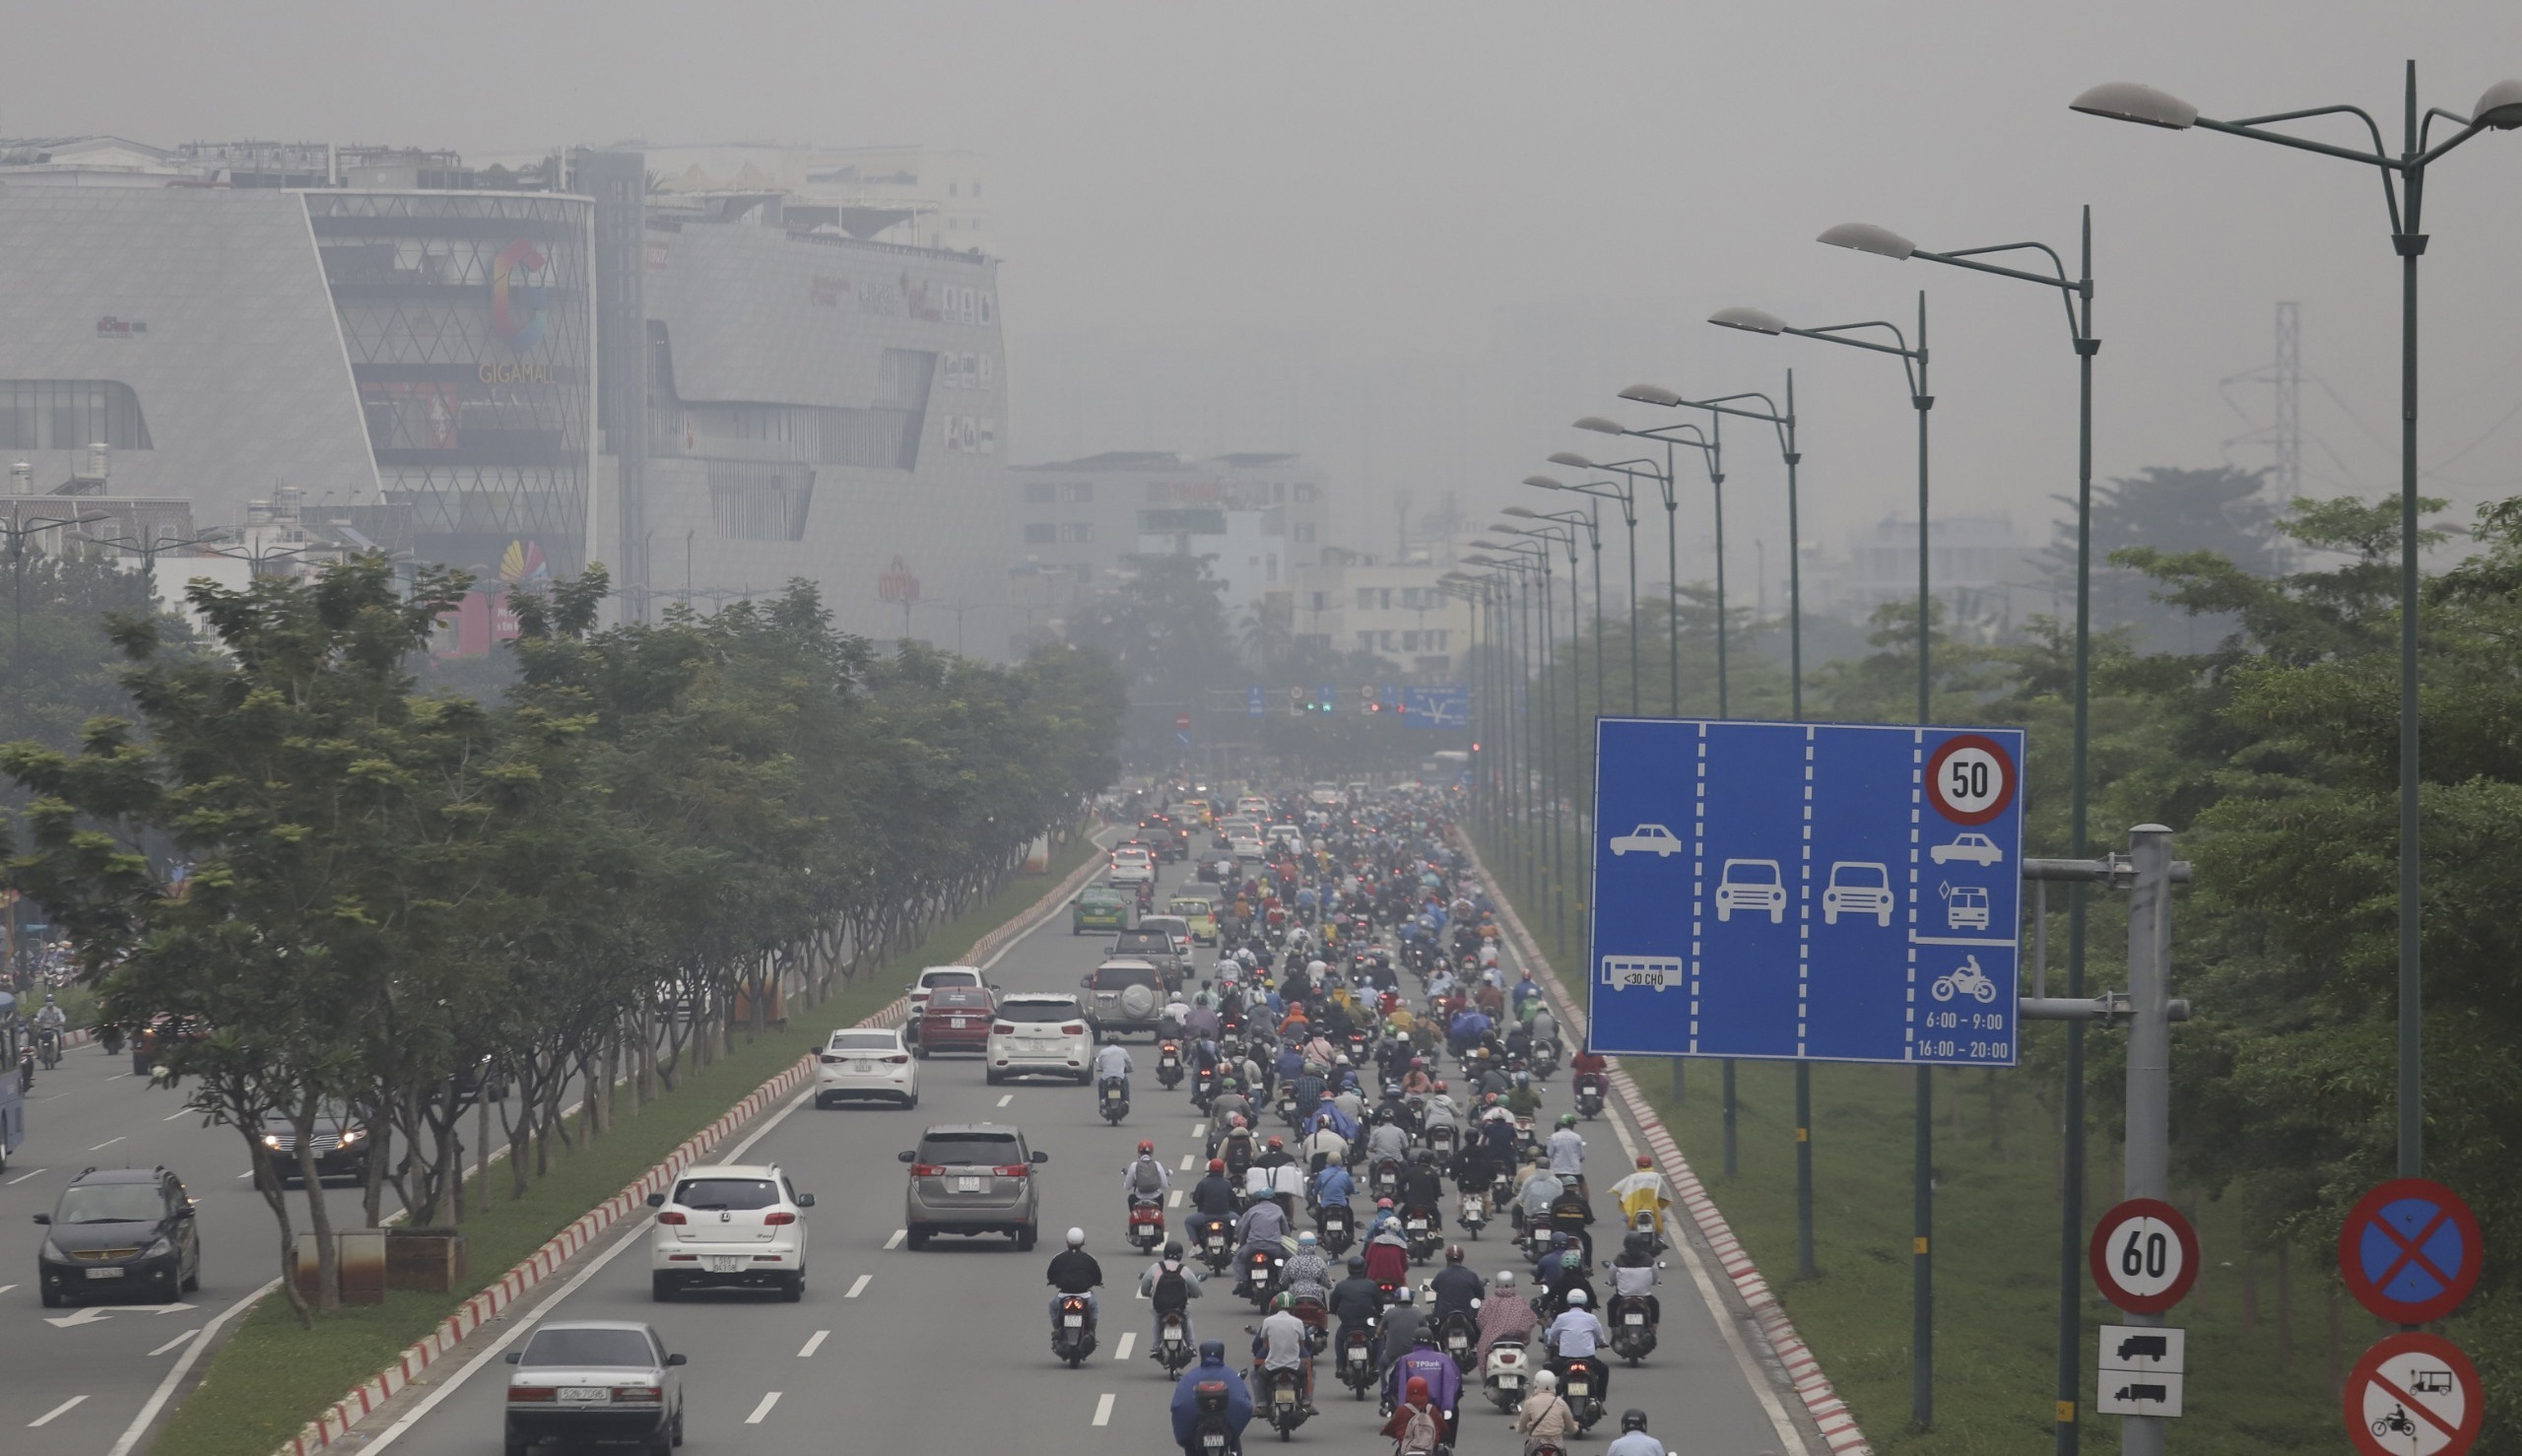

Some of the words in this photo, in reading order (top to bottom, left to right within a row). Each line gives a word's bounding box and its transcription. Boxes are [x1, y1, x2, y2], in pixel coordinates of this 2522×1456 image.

[479, 361, 557, 384] GIGAMALL
[1952, 761, 1988, 798] 50
[1624, 973, 1642, 984] <30
[1926, 1012, 1957, 1028] 6:00
[1972, 1013, 2003, 1030] 9:00
[1917, 1039, 1955, 1057] 16:00
[1970, 1041, 2008, 1058] 20:00
[2122, 1230, 2166, 1279] 60
